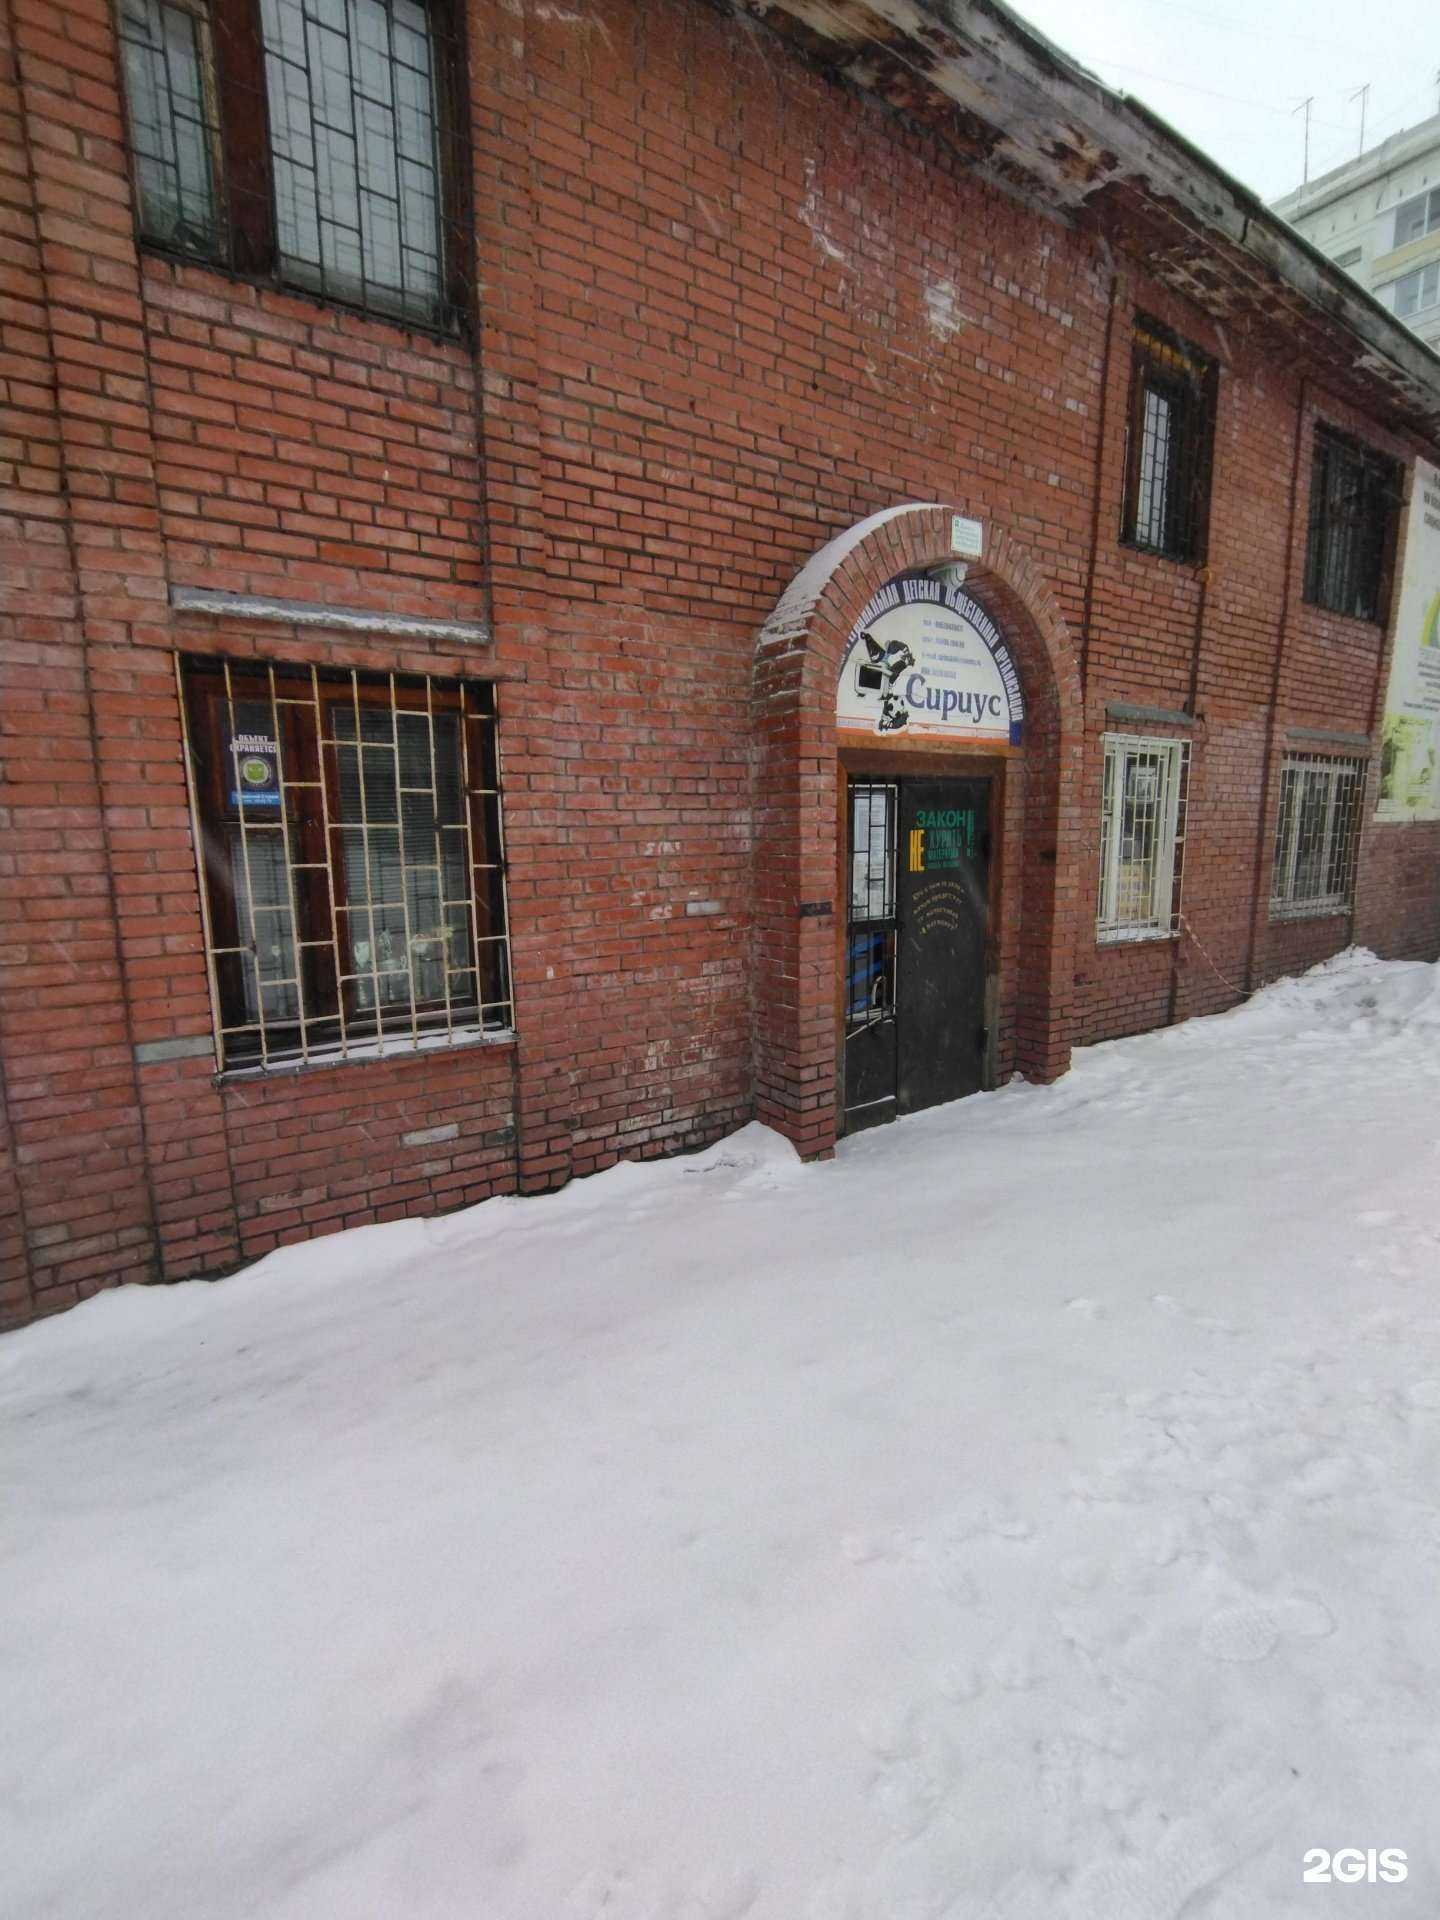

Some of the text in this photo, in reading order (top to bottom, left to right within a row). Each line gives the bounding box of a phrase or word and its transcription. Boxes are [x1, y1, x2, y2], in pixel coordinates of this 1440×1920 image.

[902, 579, 941, 602] ДЕТСКАЯ
[994, 646, 1024, 721] ОРГАНИЗАЦИЯ
[905, 673, 1001, 723] Сириус
[909, 829, 925, 872] НЕ
